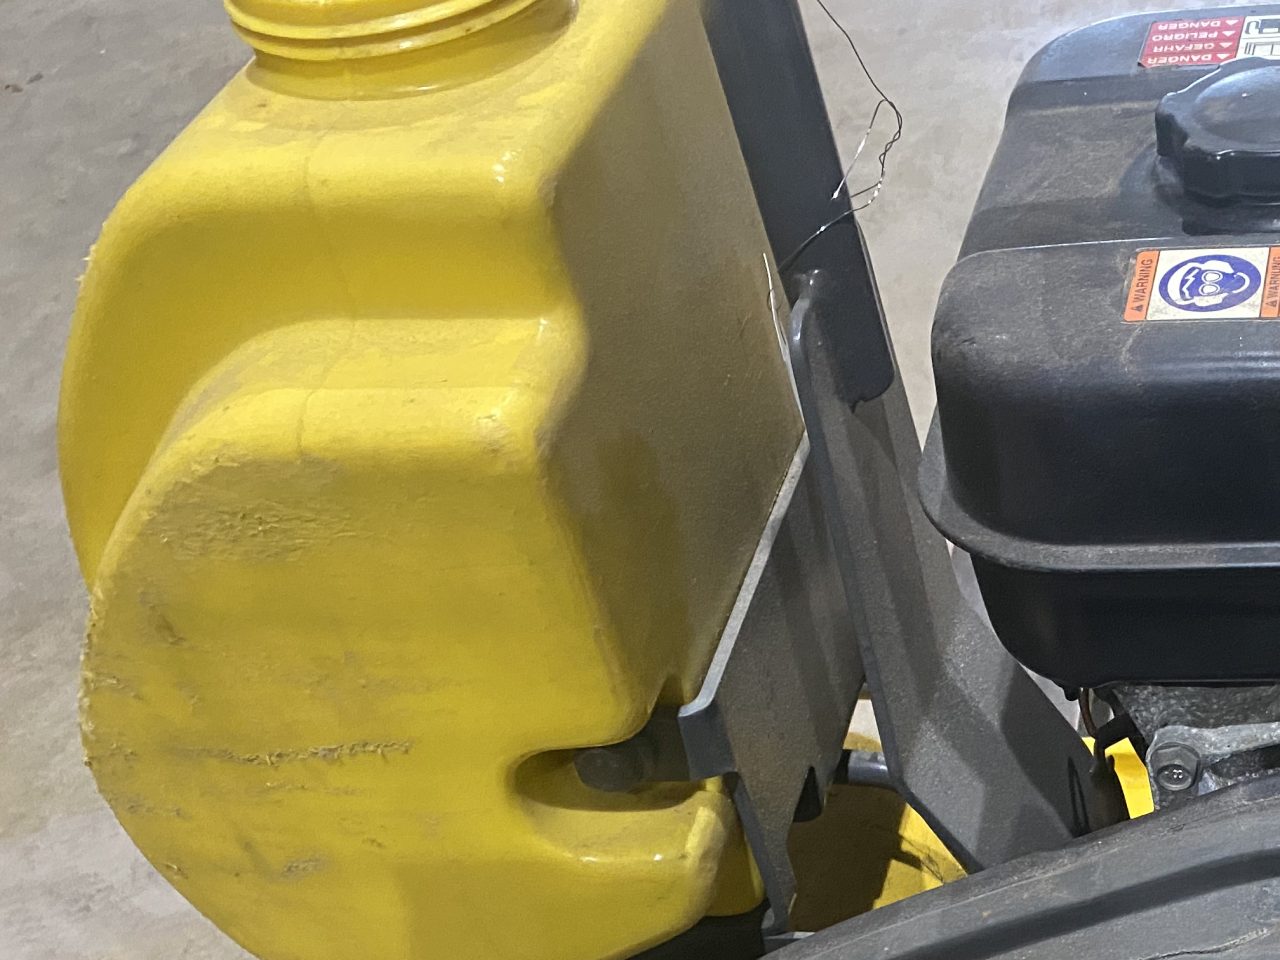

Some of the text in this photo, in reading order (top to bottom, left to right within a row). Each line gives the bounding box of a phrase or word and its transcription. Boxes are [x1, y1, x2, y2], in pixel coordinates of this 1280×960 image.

[1158, 20, 1221, 30] DANGER
[1152, 30, 1218, 41] PELIGRO
[1153, 42, 1215, 53] GEFAHR
[1147, 54, 1213, 65] DANGER
[1134, 258, 1153, 302] WARNING
